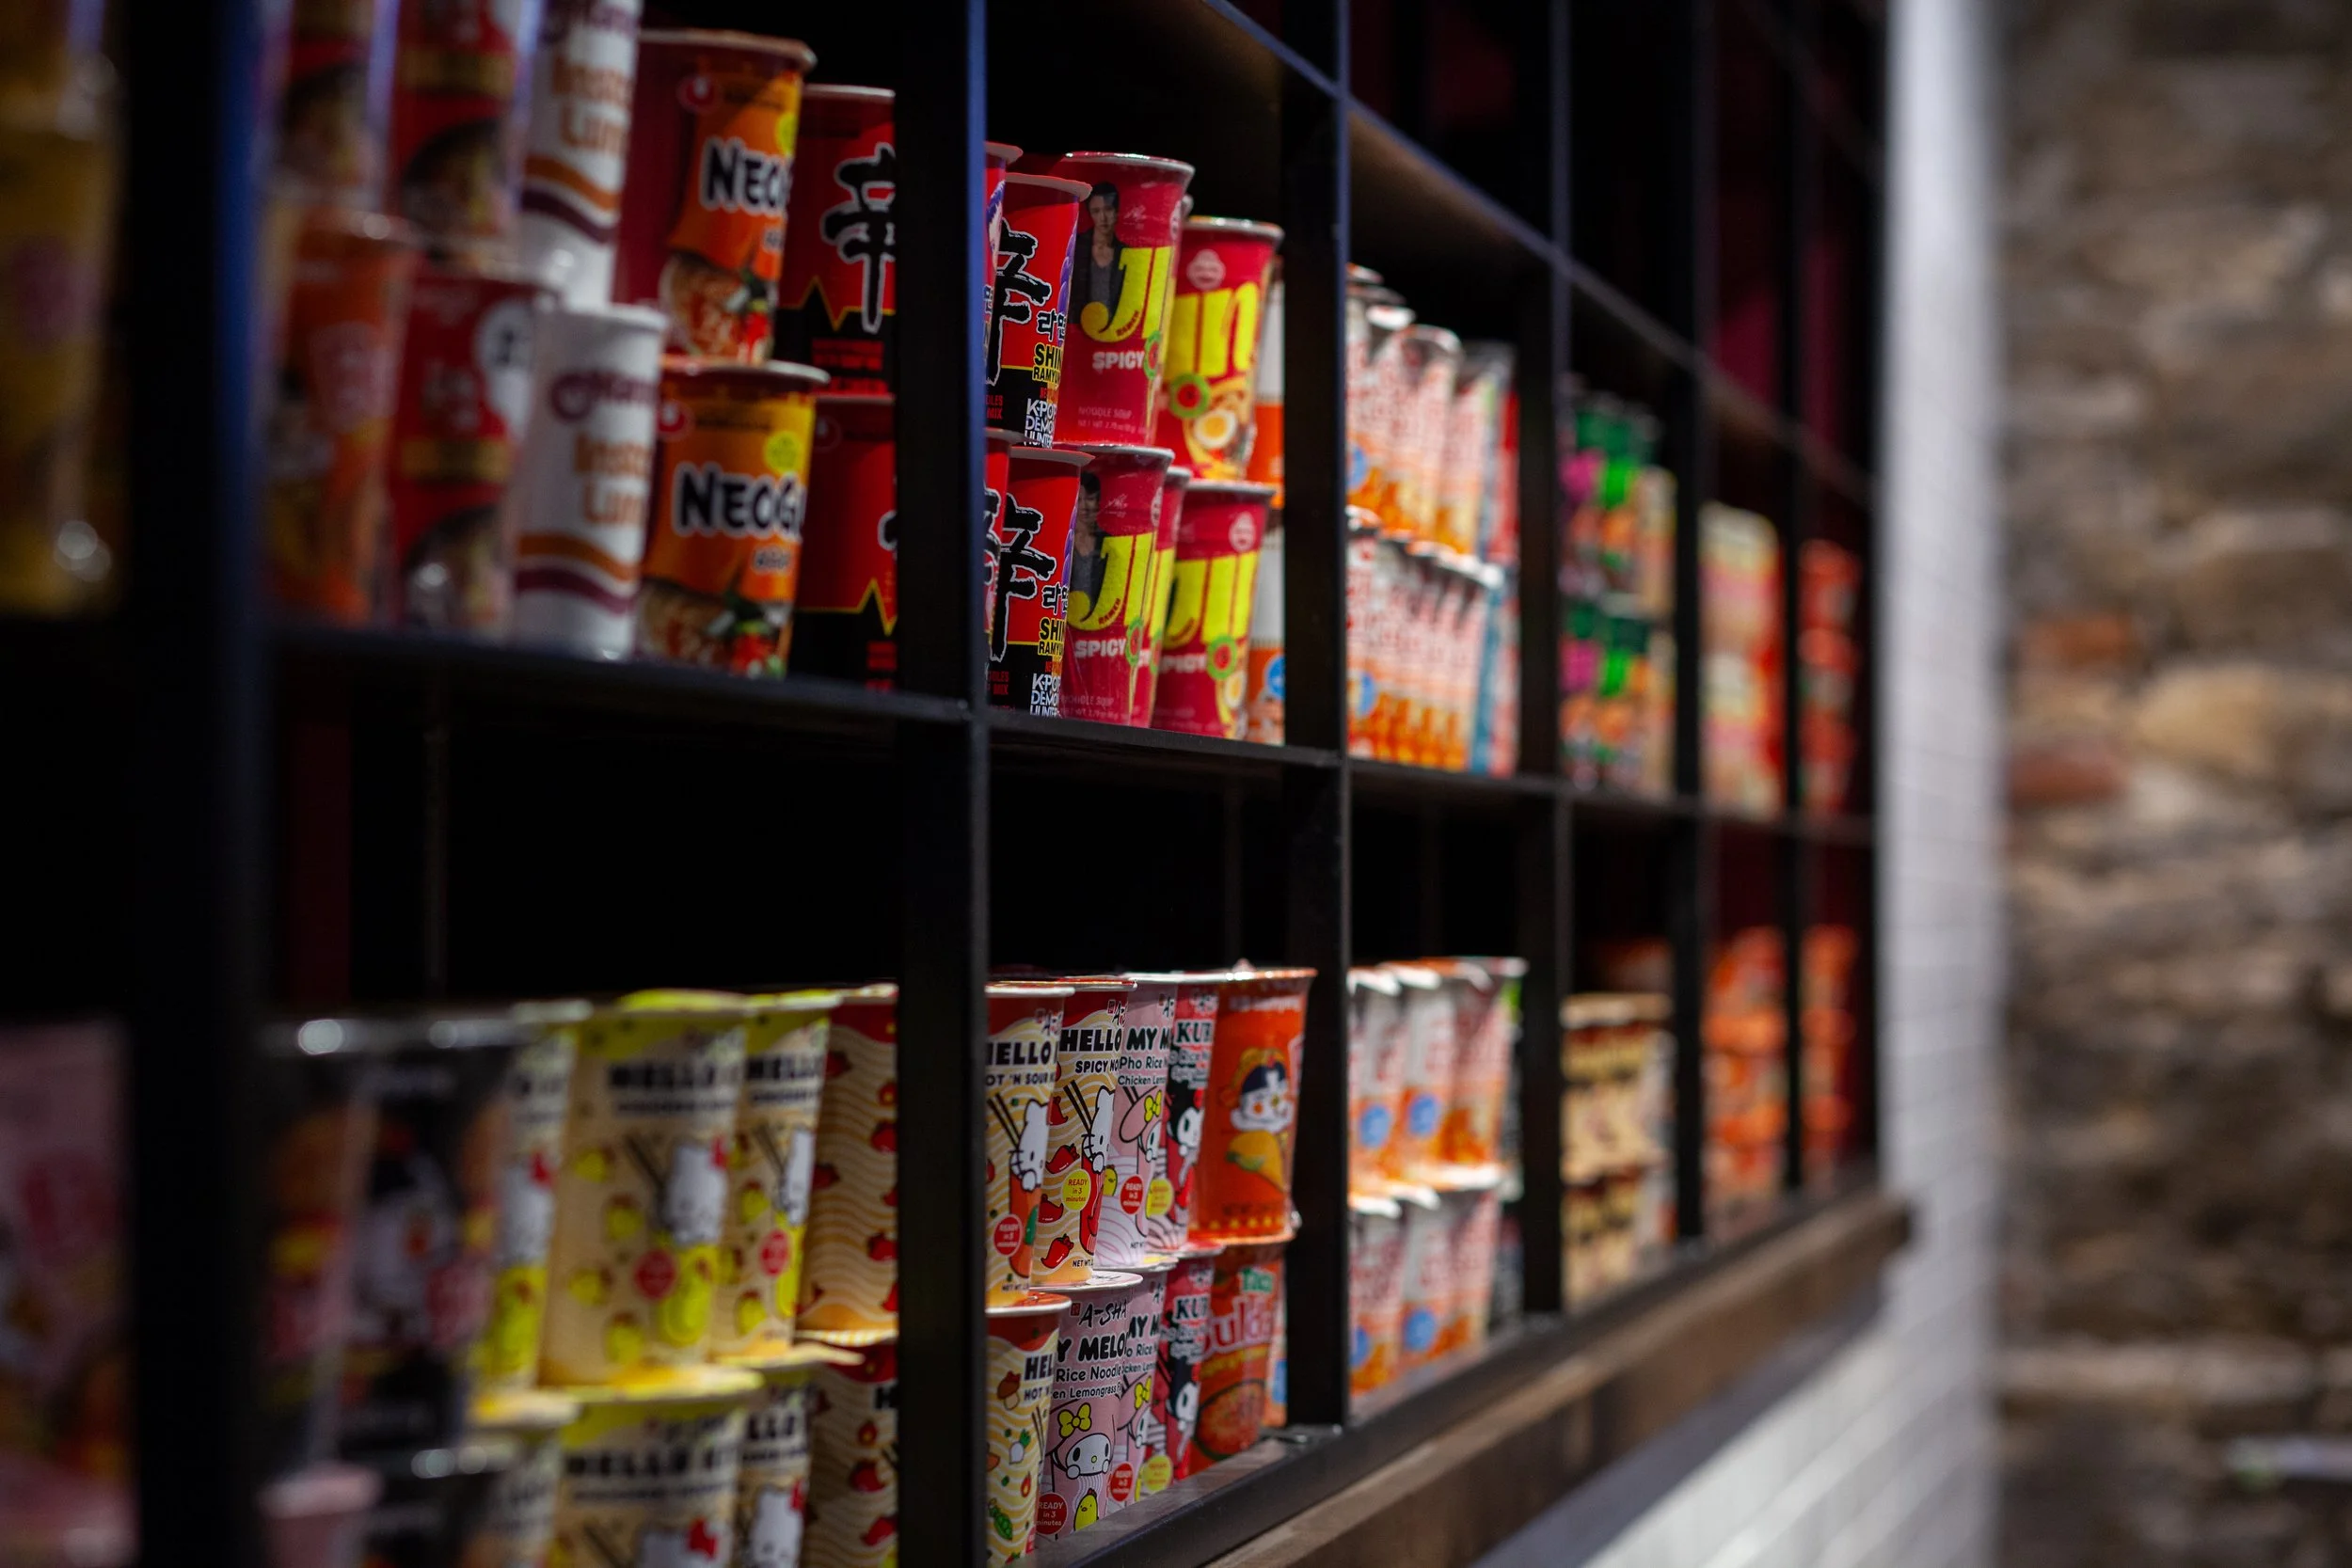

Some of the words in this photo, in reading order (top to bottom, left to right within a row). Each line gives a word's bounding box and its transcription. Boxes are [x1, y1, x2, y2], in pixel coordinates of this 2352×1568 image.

[1092, 351, 1144, 371] SPICY
[1074, 638, 1126, 657] SPICY
[1059, 1029, 1122, 1052] HELLO
[1126, 1028, 1157, 1051] MY
[1075, 1060, 1108, 1073] SPICY
[1120, 1055, 1142, 1070] Pho
[1146, 1057, 1163, 1069] Rice
[1118, 1075, 1151, 1085] Chicken
[1056, 1368, 1086, 1383] Rice
[1070, 1386, 1117, 1398] Lemongrass
[1039, 1501, 1063, 1510] READY
